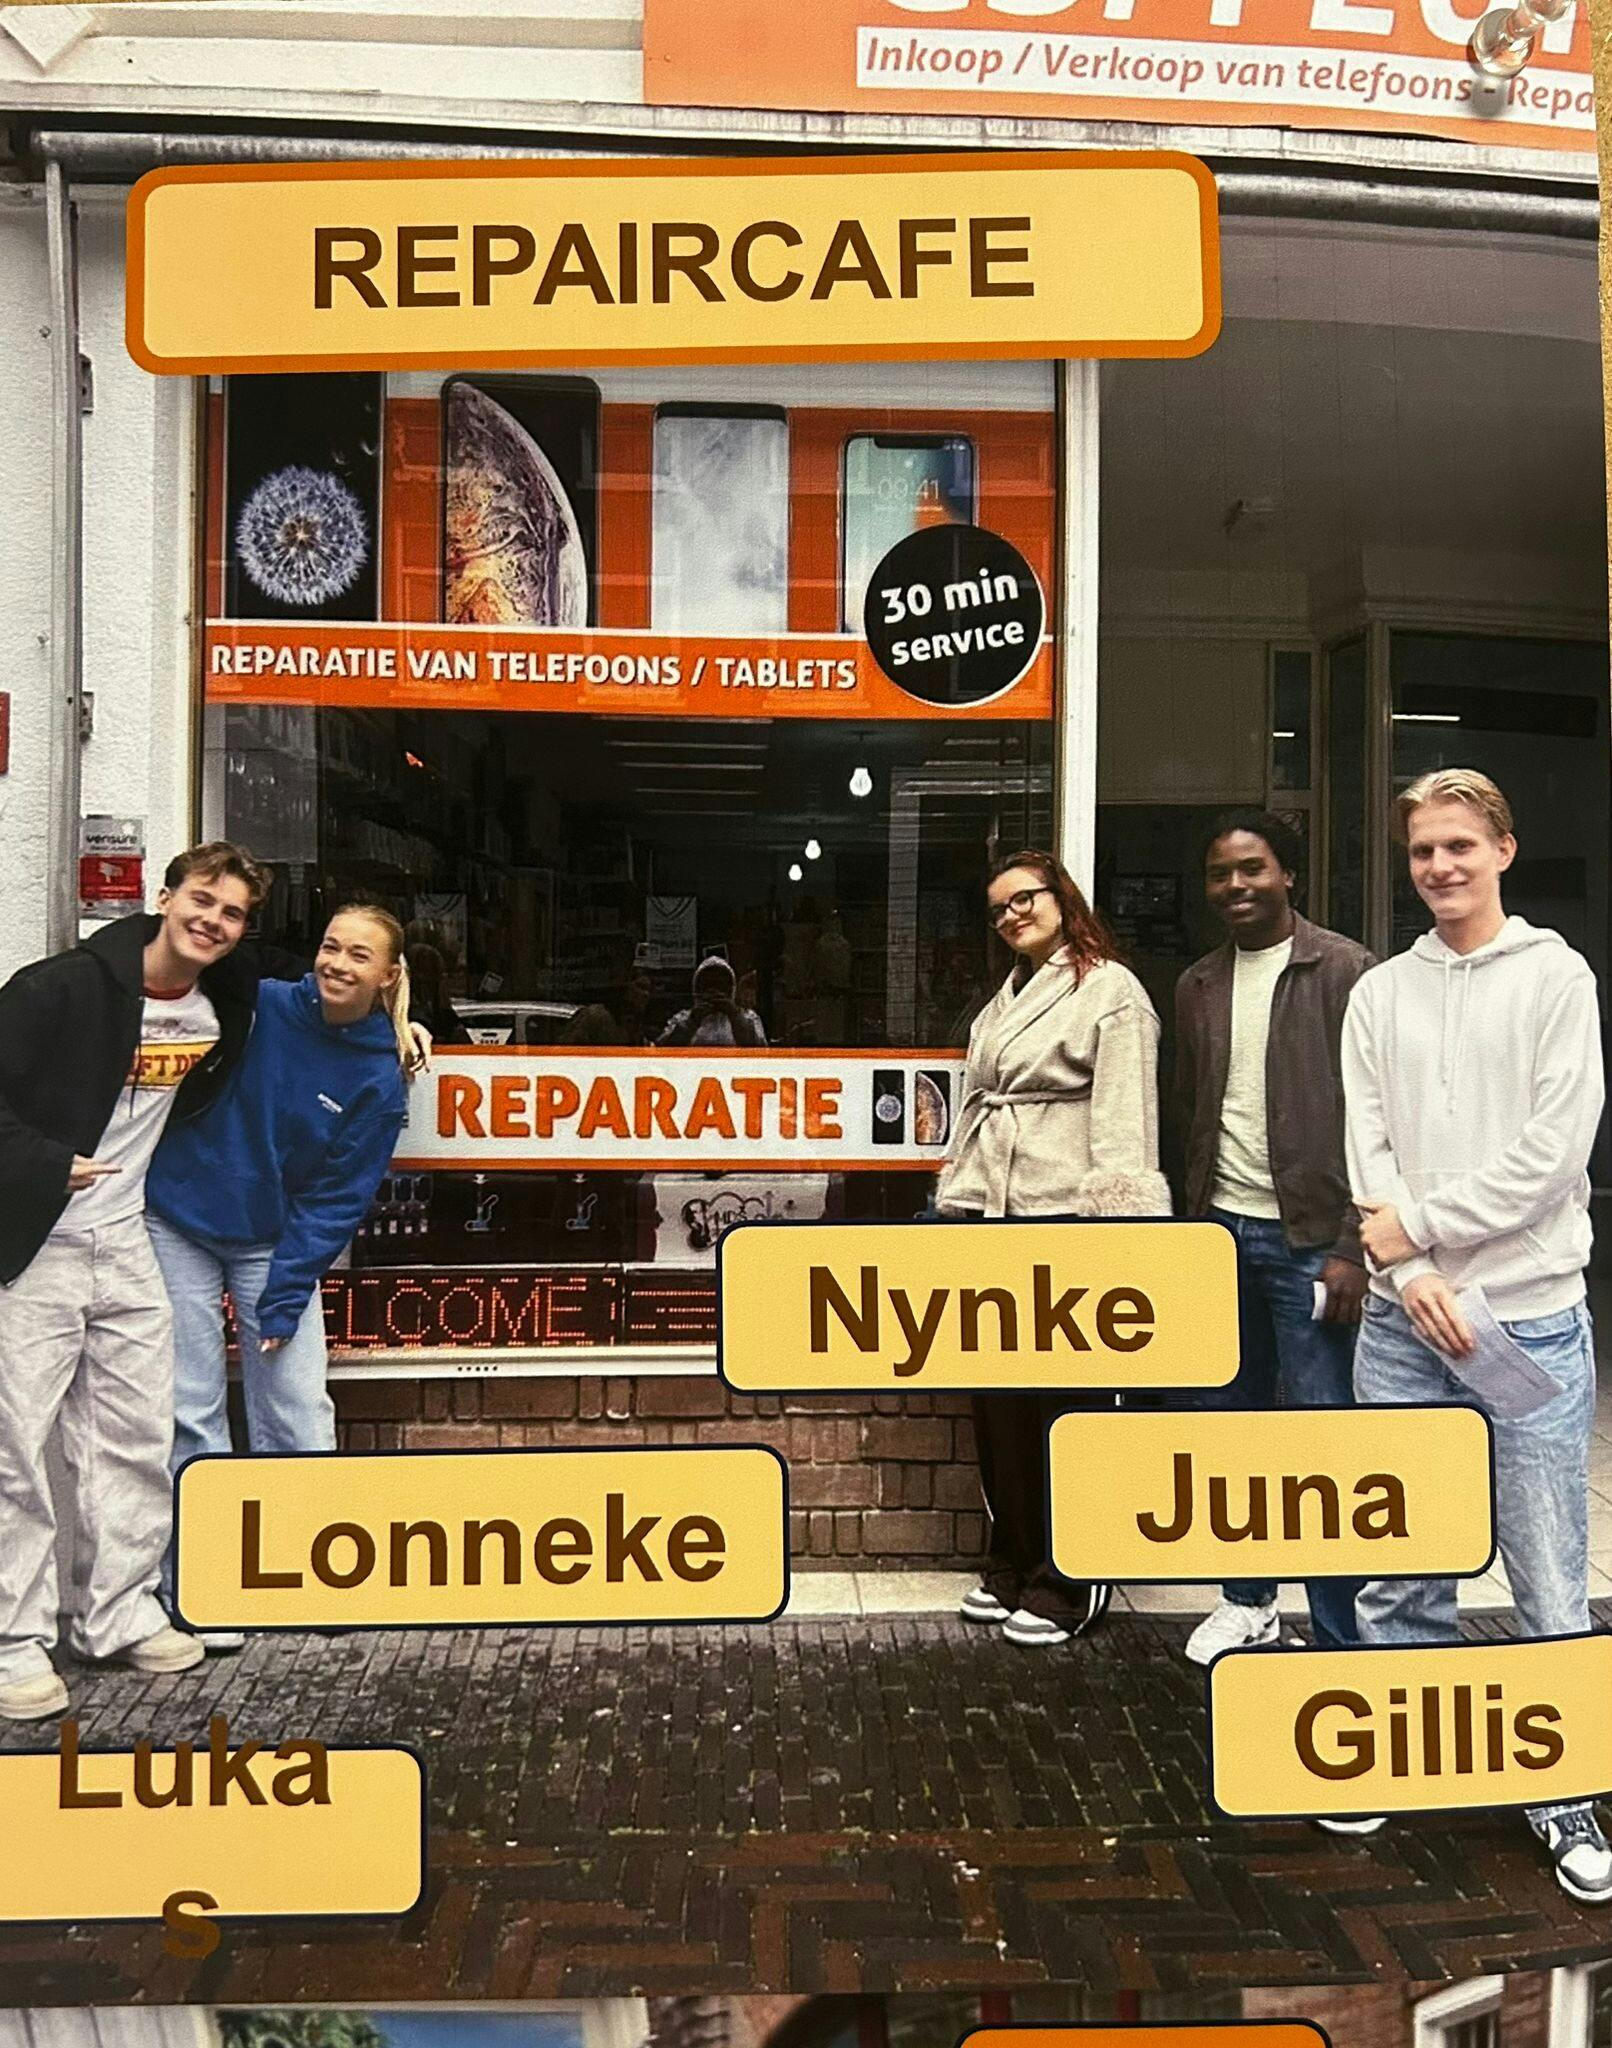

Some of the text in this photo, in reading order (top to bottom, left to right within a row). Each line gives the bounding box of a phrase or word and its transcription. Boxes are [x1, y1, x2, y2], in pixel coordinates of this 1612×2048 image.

[866, 37, 1003, 84] Inkoop
[1013, 43, 1033, 75] /
[1044, 44, 1204, 93] Verkoop
[1216, 60, 1284, 88] van
[1297, 59, 1472, 102] telefoons
[313, 216, 1036, 309] REPAIRCAFE
[881, 568, 1019, 625] 30 min
[211, 645, 857, 690] REPARATIE VAN TELEFOONS / TABLETS
[437, 1074, 844, 1140] REPARATIE
[809, 1264, 1155, 1377] Nynke
[241, 1493, 727, 1589] Lonneke
[1136, 1452, 1410, 1543] Juna
[59, 1714, 332, 1809] Luka
[1294, 1683, 1565, 1781] Gillis
[162, 1890, 221, 1959] s
